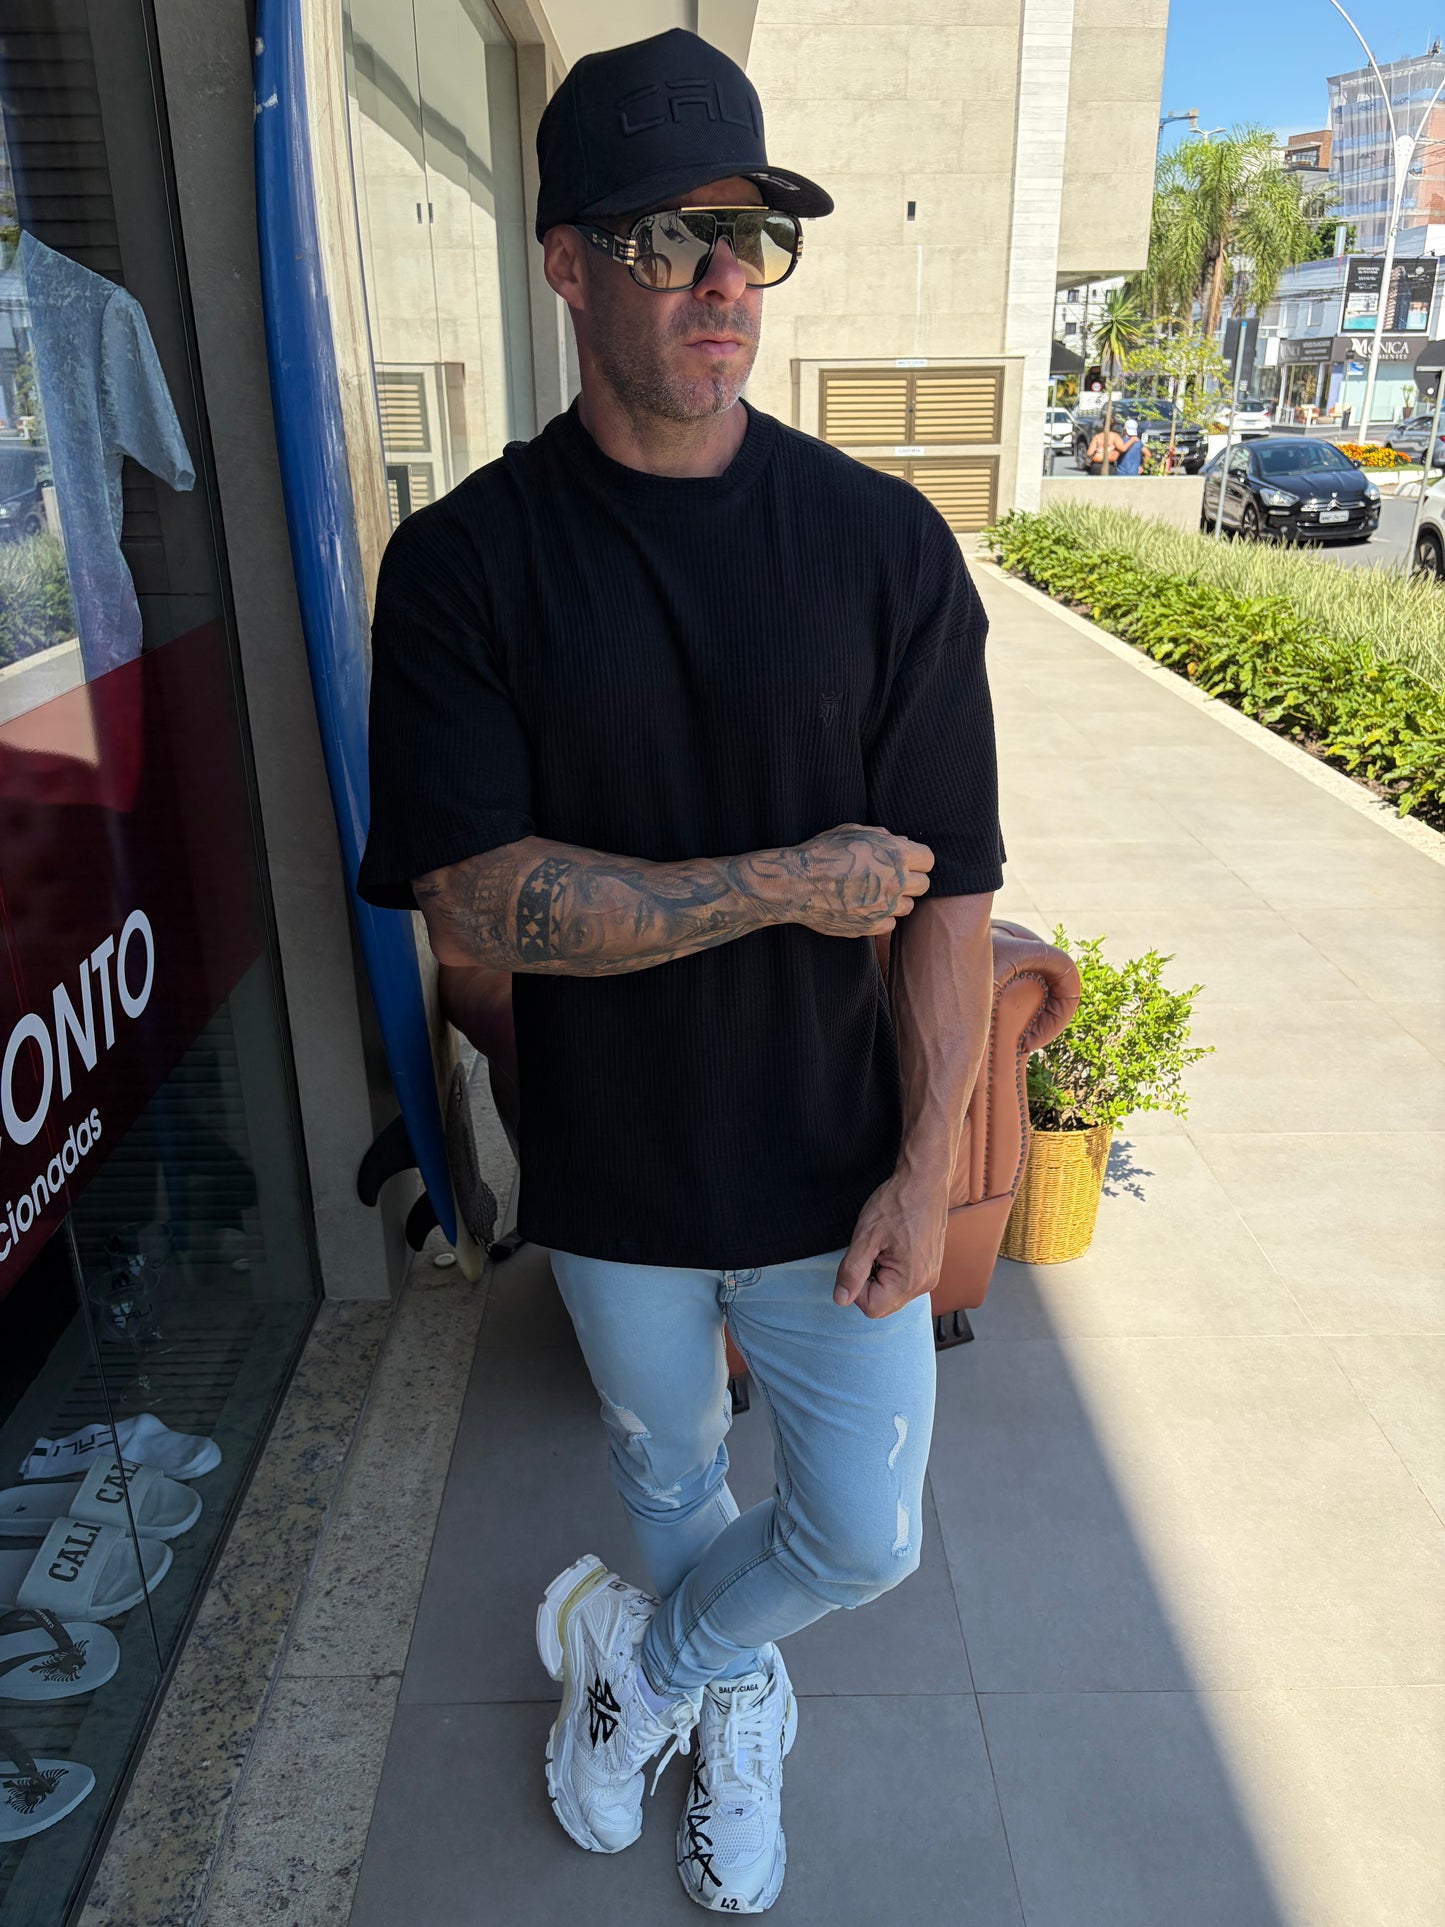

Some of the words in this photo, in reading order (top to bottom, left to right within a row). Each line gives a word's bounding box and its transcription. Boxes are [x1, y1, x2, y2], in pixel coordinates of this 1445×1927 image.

[0, 910, 155, 1152] ONTO
[95, 1459, 143, 1504] CAL
[48, 1522, 102, 1582] CALI
[718, 1683, 759, 1694] BALECIAGA
[720, 1898, 740, 1911] 42
